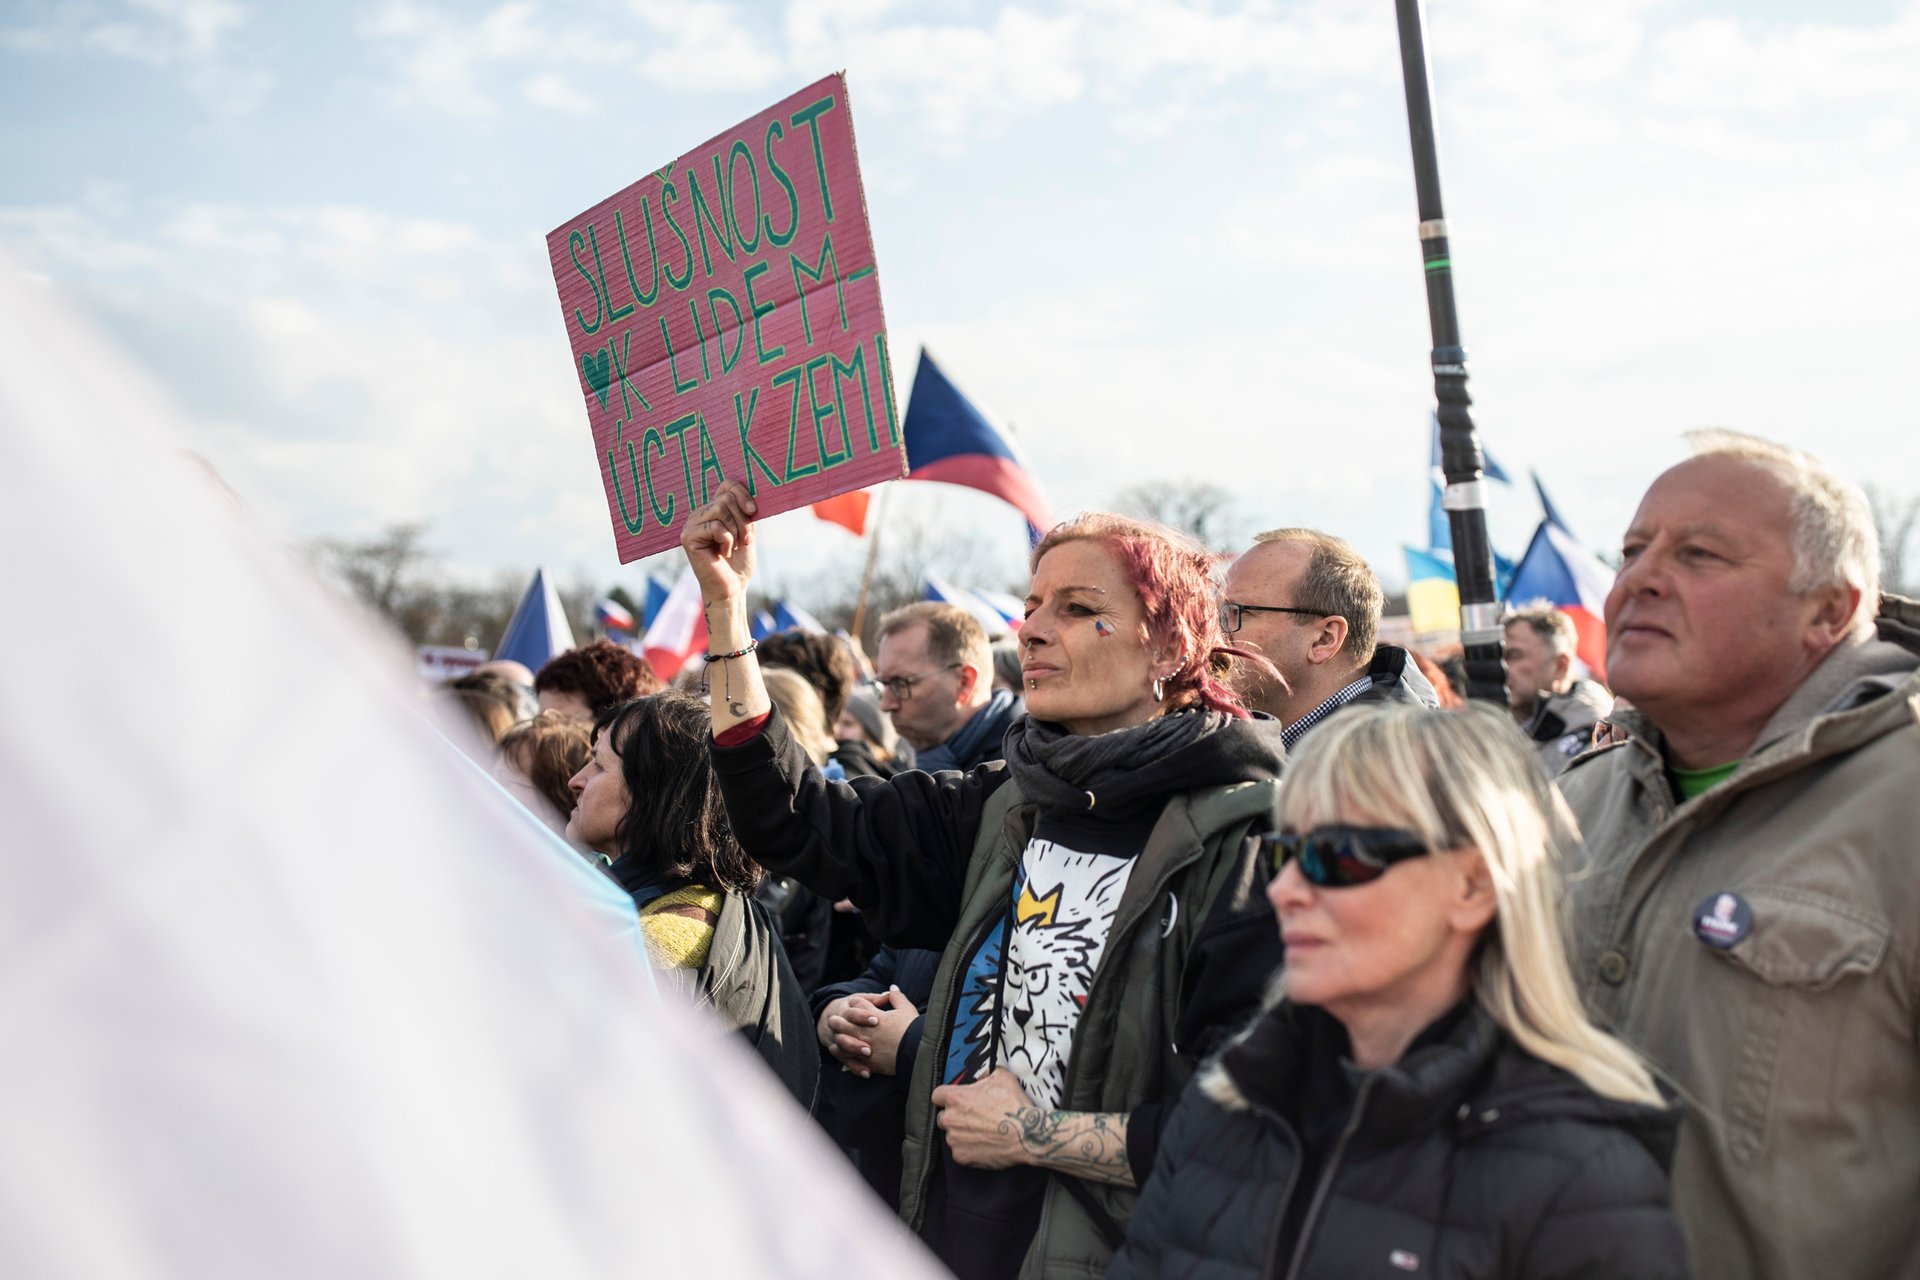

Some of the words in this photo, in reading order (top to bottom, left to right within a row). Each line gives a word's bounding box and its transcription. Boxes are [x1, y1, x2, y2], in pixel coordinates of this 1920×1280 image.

[568, 95, 836, 336] SLUŠNOST
[607, 410, 726, 536] ÚCTA
[733, 386, 783, 498] K
[772, 331, 899, 485] ZEMI
[608, 329, 653, 422] K
